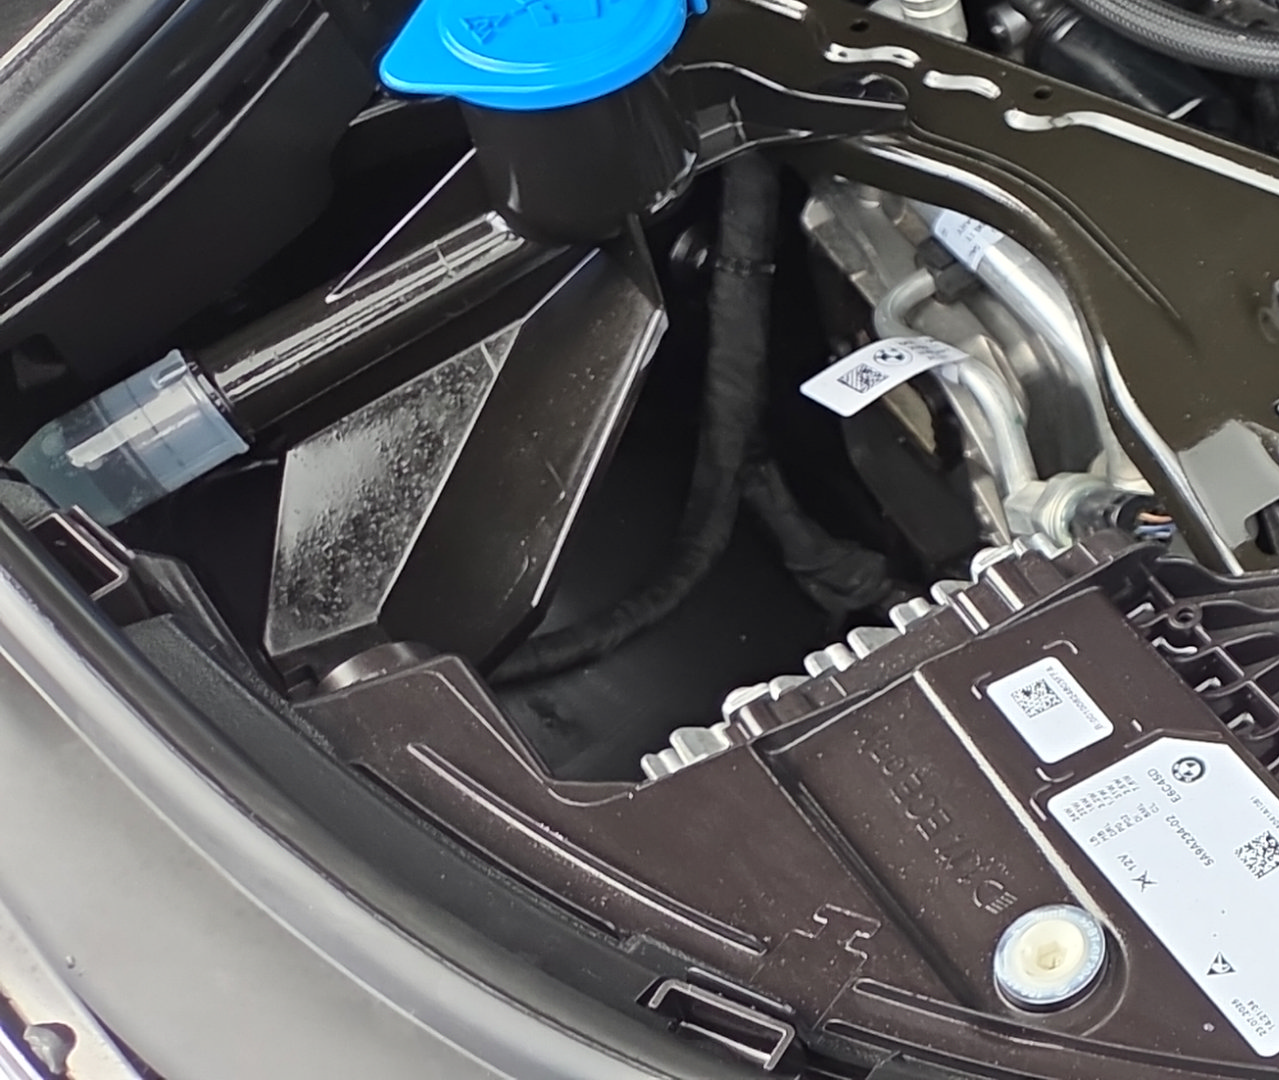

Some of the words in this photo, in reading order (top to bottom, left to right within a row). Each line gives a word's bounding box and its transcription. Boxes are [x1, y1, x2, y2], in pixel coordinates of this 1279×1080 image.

[1148, 769, 1181, 803] E6C45D
[1166, 816, 1214, 866] 5A9A234-02
[1117, 853, 1137, 872] 12V
